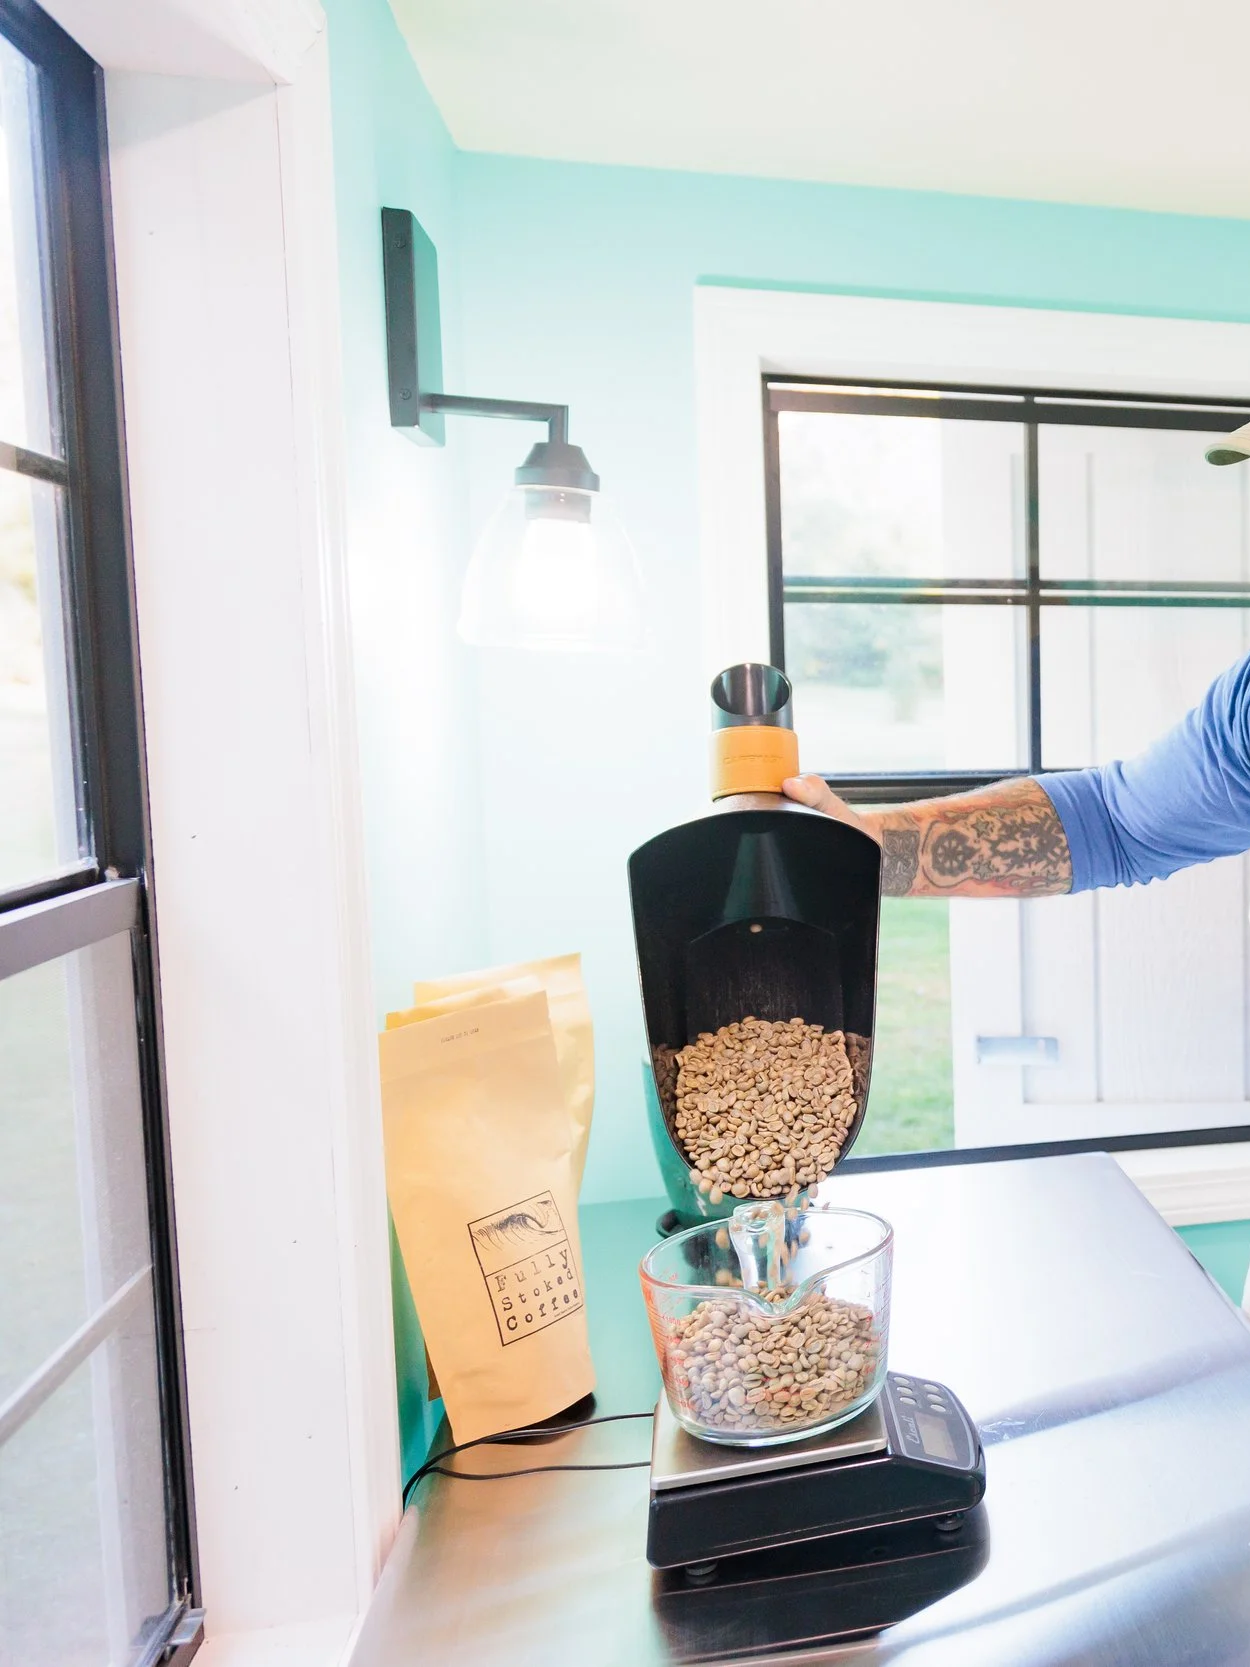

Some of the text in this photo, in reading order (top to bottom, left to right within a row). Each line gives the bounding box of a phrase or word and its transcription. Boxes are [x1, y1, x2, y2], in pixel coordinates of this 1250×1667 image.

[494, 1248, 568, 1293] Fully
[501, 1268, 574, 1312] Stoked
[506, 1289, 579, 1331] Coffee
